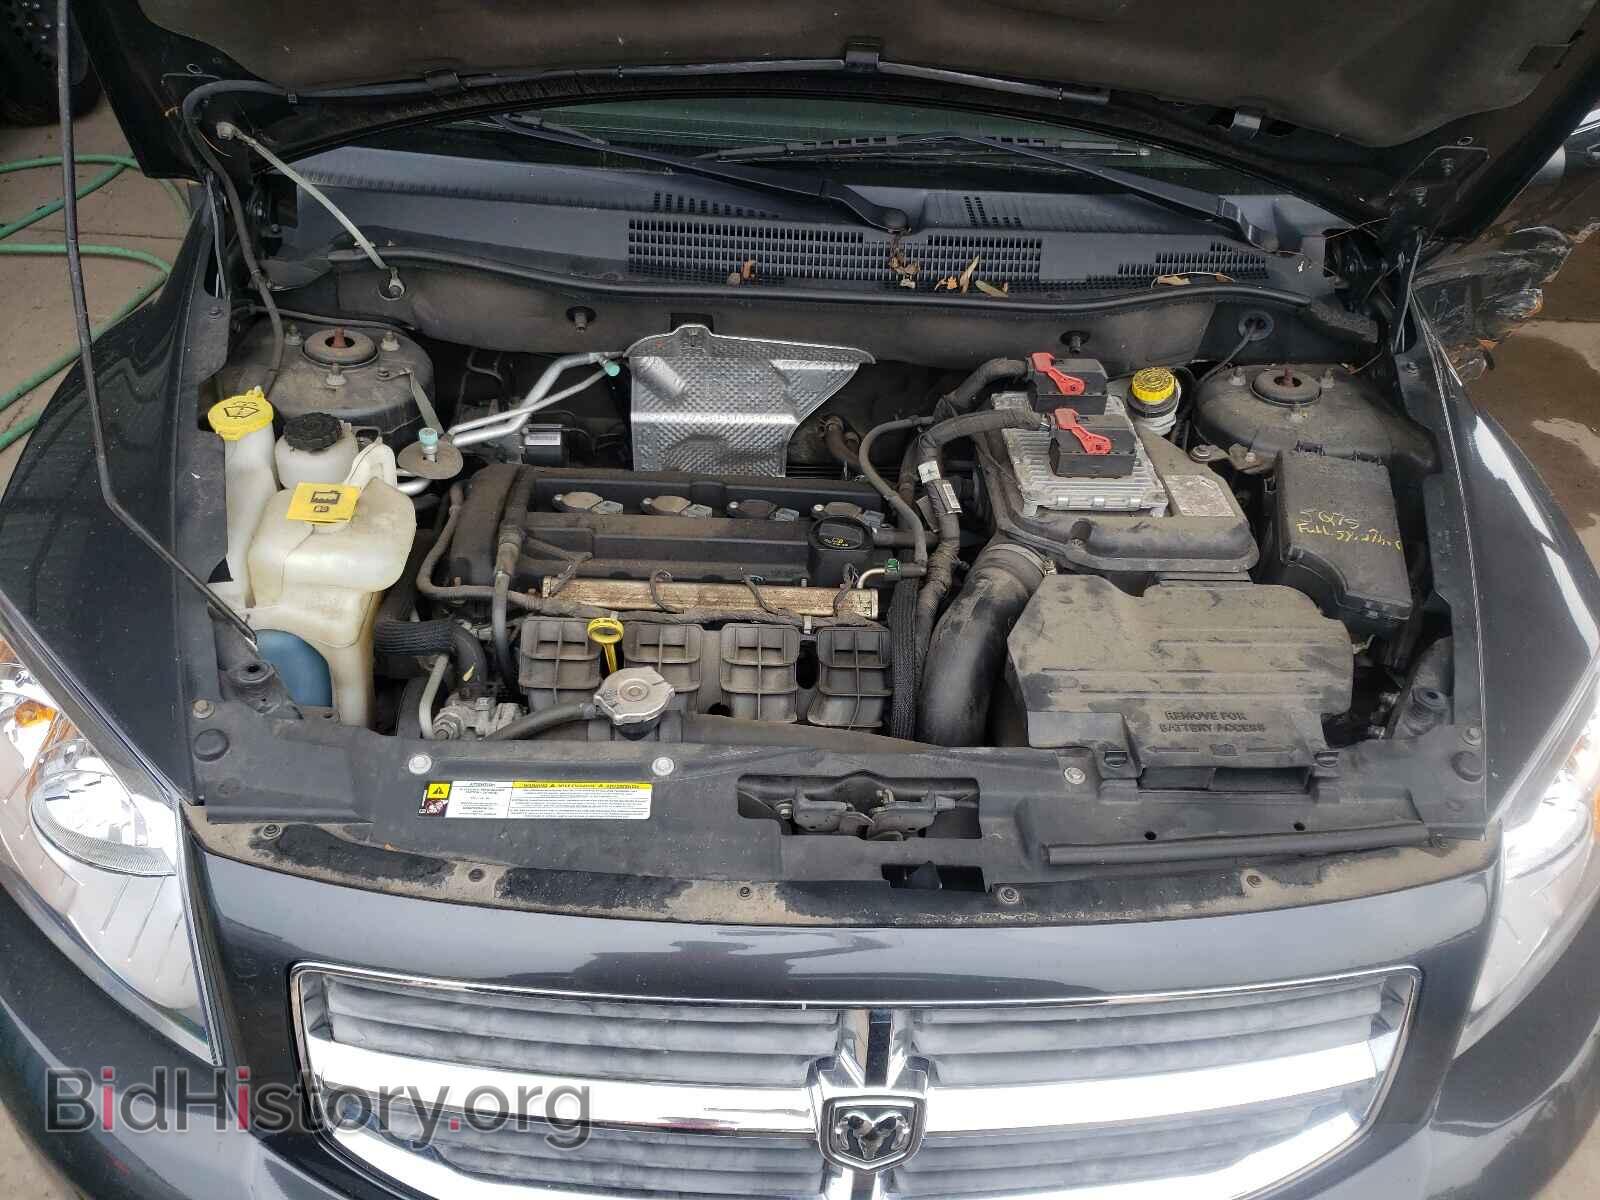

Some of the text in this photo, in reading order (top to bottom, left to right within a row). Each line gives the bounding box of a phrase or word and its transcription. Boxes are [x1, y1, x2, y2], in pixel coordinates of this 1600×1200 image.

[1164, 711, 1248, 721] REMOVE FOR
[1159, 723, 1266, 733] BATTERY ACCESS
